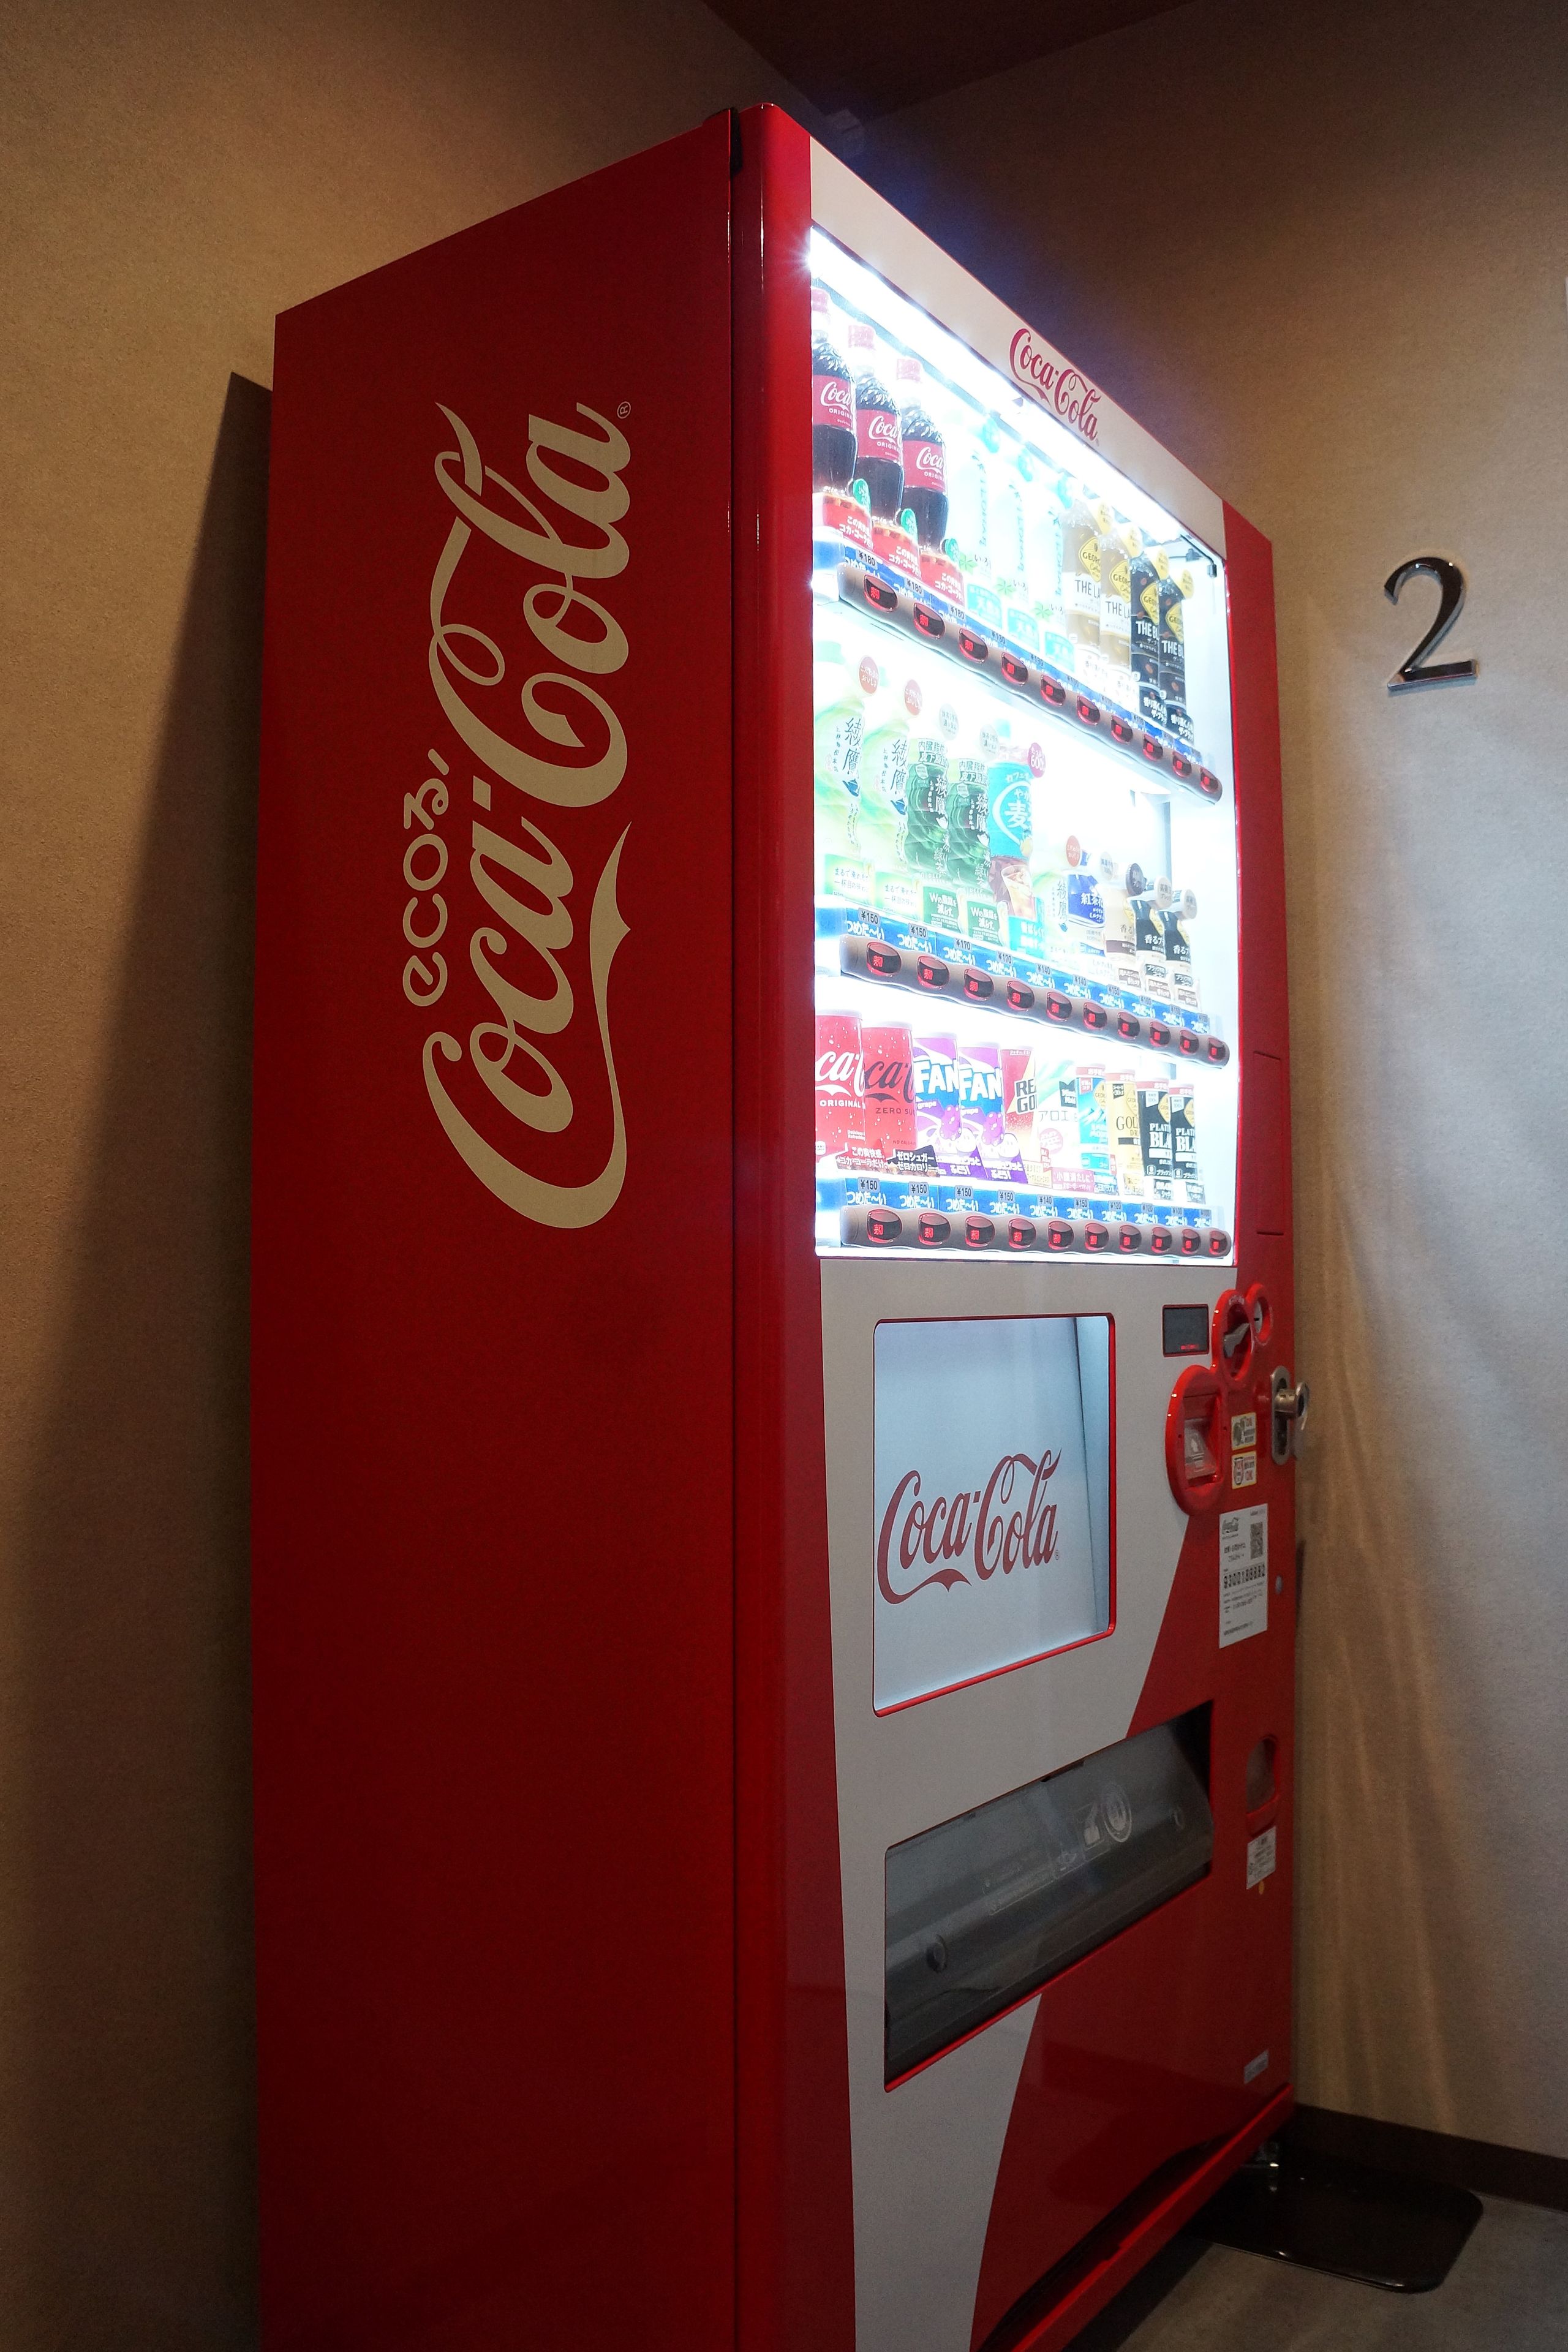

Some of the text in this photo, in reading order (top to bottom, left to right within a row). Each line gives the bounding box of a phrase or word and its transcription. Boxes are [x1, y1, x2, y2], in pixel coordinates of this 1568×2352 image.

[1009, 328, 1101, 441] Coca-Cola
[858, 551, 875, 566] ¥180
[907, 579, 922, 595] ¥180
[1074, 579, 1091, 597] THE
[1105, 601, 1122, 617] THE
[1136, 621, 1152, 636] THE
[1384, 557, 1479, 692] 2
[1161, 640, 1178, 655] THE
[423, 402, 631, 1229] Coca-Cola
[1004, 799, 1028, 829] 麦
[861, 910, 878, 924] ¥150
[910, 925, 927, 938] ¥150
[956, 938, 971, 950] ¥170
[998, 952, 1011, 963] ¥170
[1038, 964, 1051, 975] ¥140
[820, 1099, 861, 1109] ORIGINAL
[1038, 1110, 1069, 1122] アロエ
[897, 1152, 935, 1162] ゼロシュガー
[860, 1179, 878, 1191] ¥150
[911, 1184, 927, 1194] ¥150
[956, 1188, 971, 1197] ¥150
[1000, 1192, 1014, 1202] ¥150
[1039, 1196, 1052, 1205] ¥140
[1076, 1199, 1088, 1208] ¥150
[877, 1448, 1062, 1605] Coca-Cola
